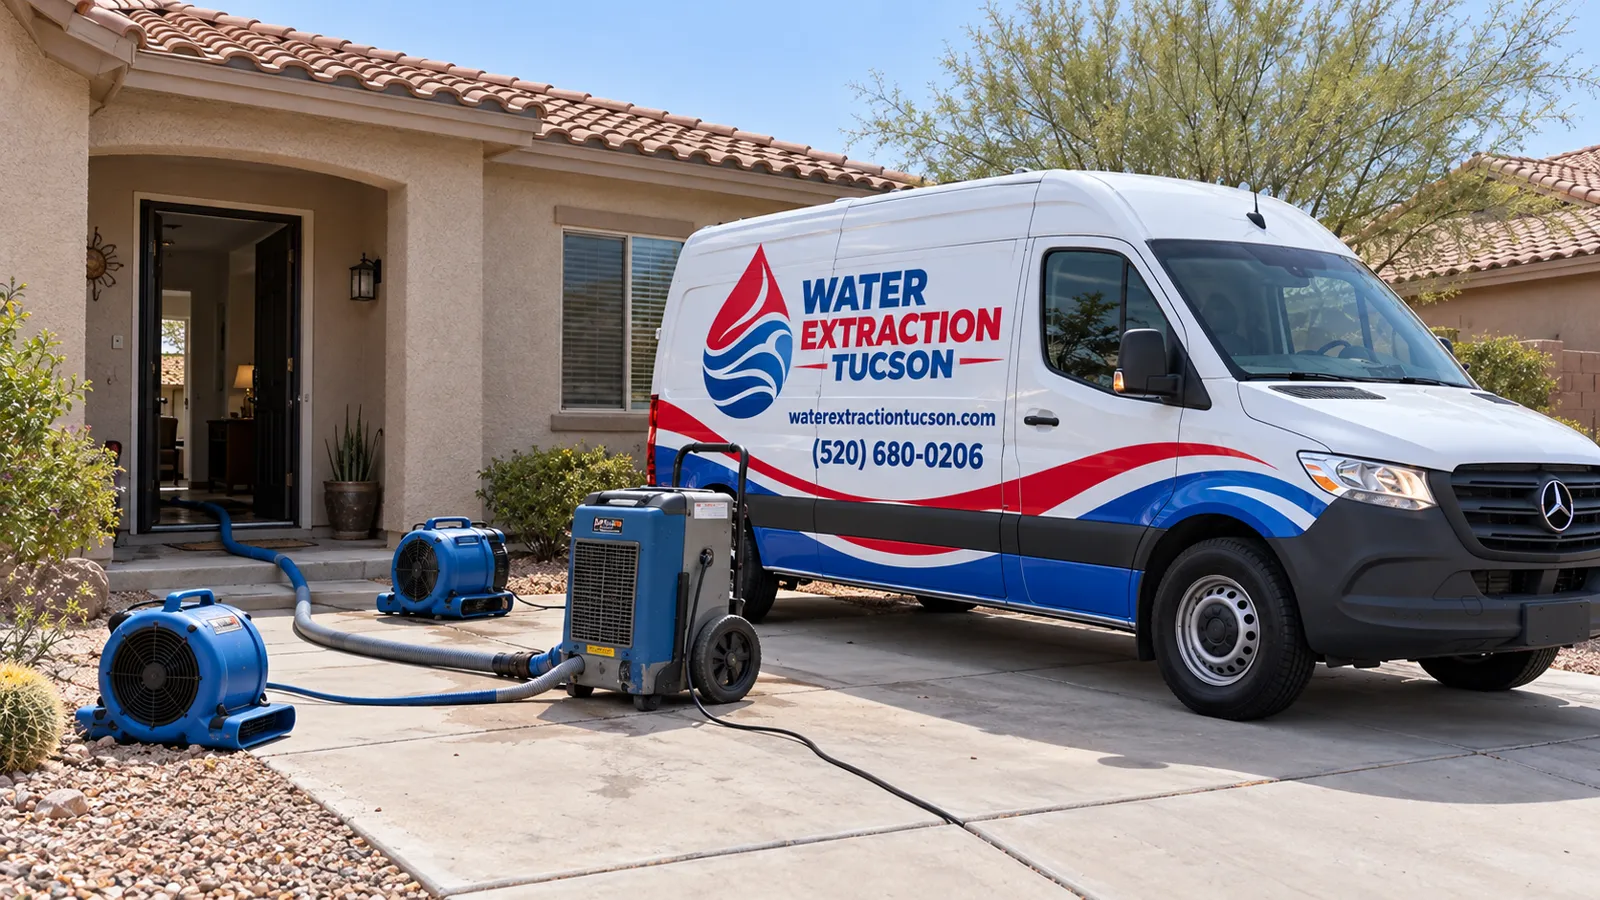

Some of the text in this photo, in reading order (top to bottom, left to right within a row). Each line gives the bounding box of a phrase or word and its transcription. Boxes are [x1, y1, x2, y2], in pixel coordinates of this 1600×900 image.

[803, 269, 927, 314] WATER
[801, 307, 1002, 350] EXTRACTION
[832, 349, 954, 381] TUCSON
[789, 407, 995, 426] waterextractiontucson.com
[812, 438, 983, 470] (520) 680-0206
